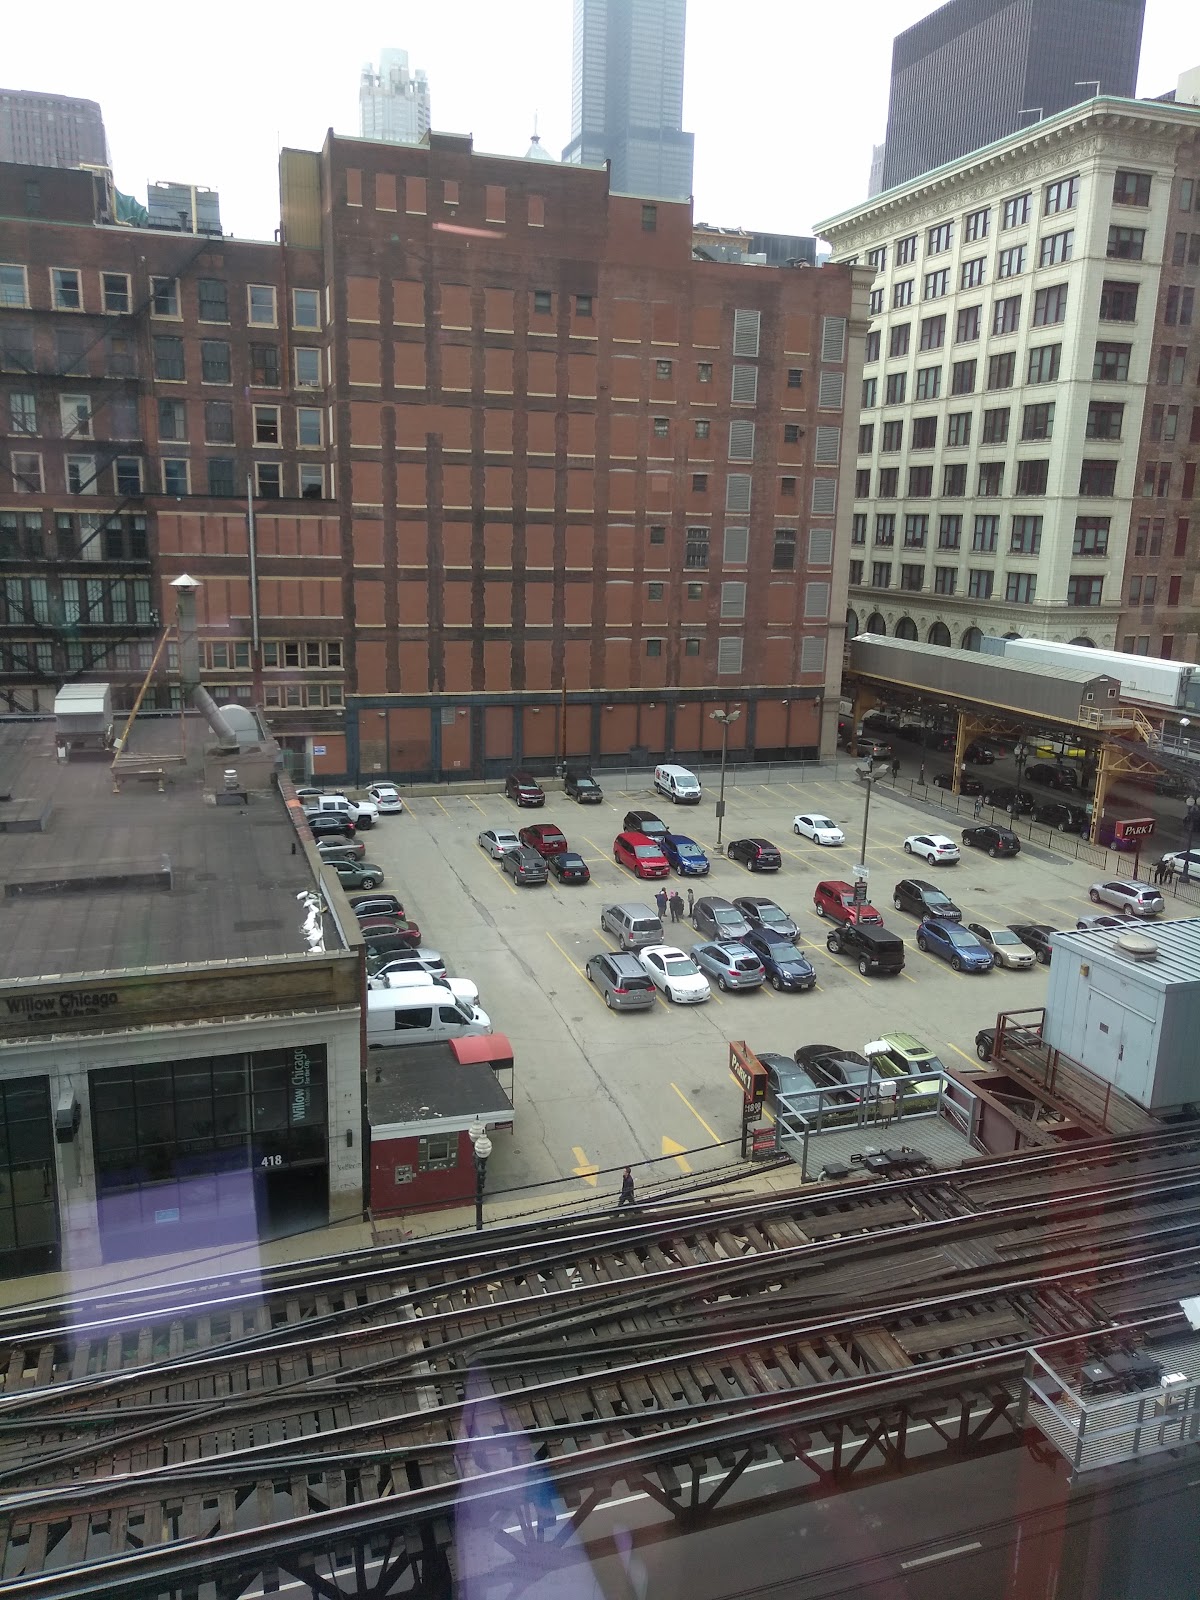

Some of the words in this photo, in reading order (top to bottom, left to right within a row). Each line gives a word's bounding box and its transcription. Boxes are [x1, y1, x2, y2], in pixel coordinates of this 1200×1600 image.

[6, 997, 56, 1014] Willow
[59, 992, 118, 1008] Chicago
[292, 1048, 307, 1085] Chicago
[292, 1088, 305, 1121] Willow
[261, 1154, 282, 1167] 418
